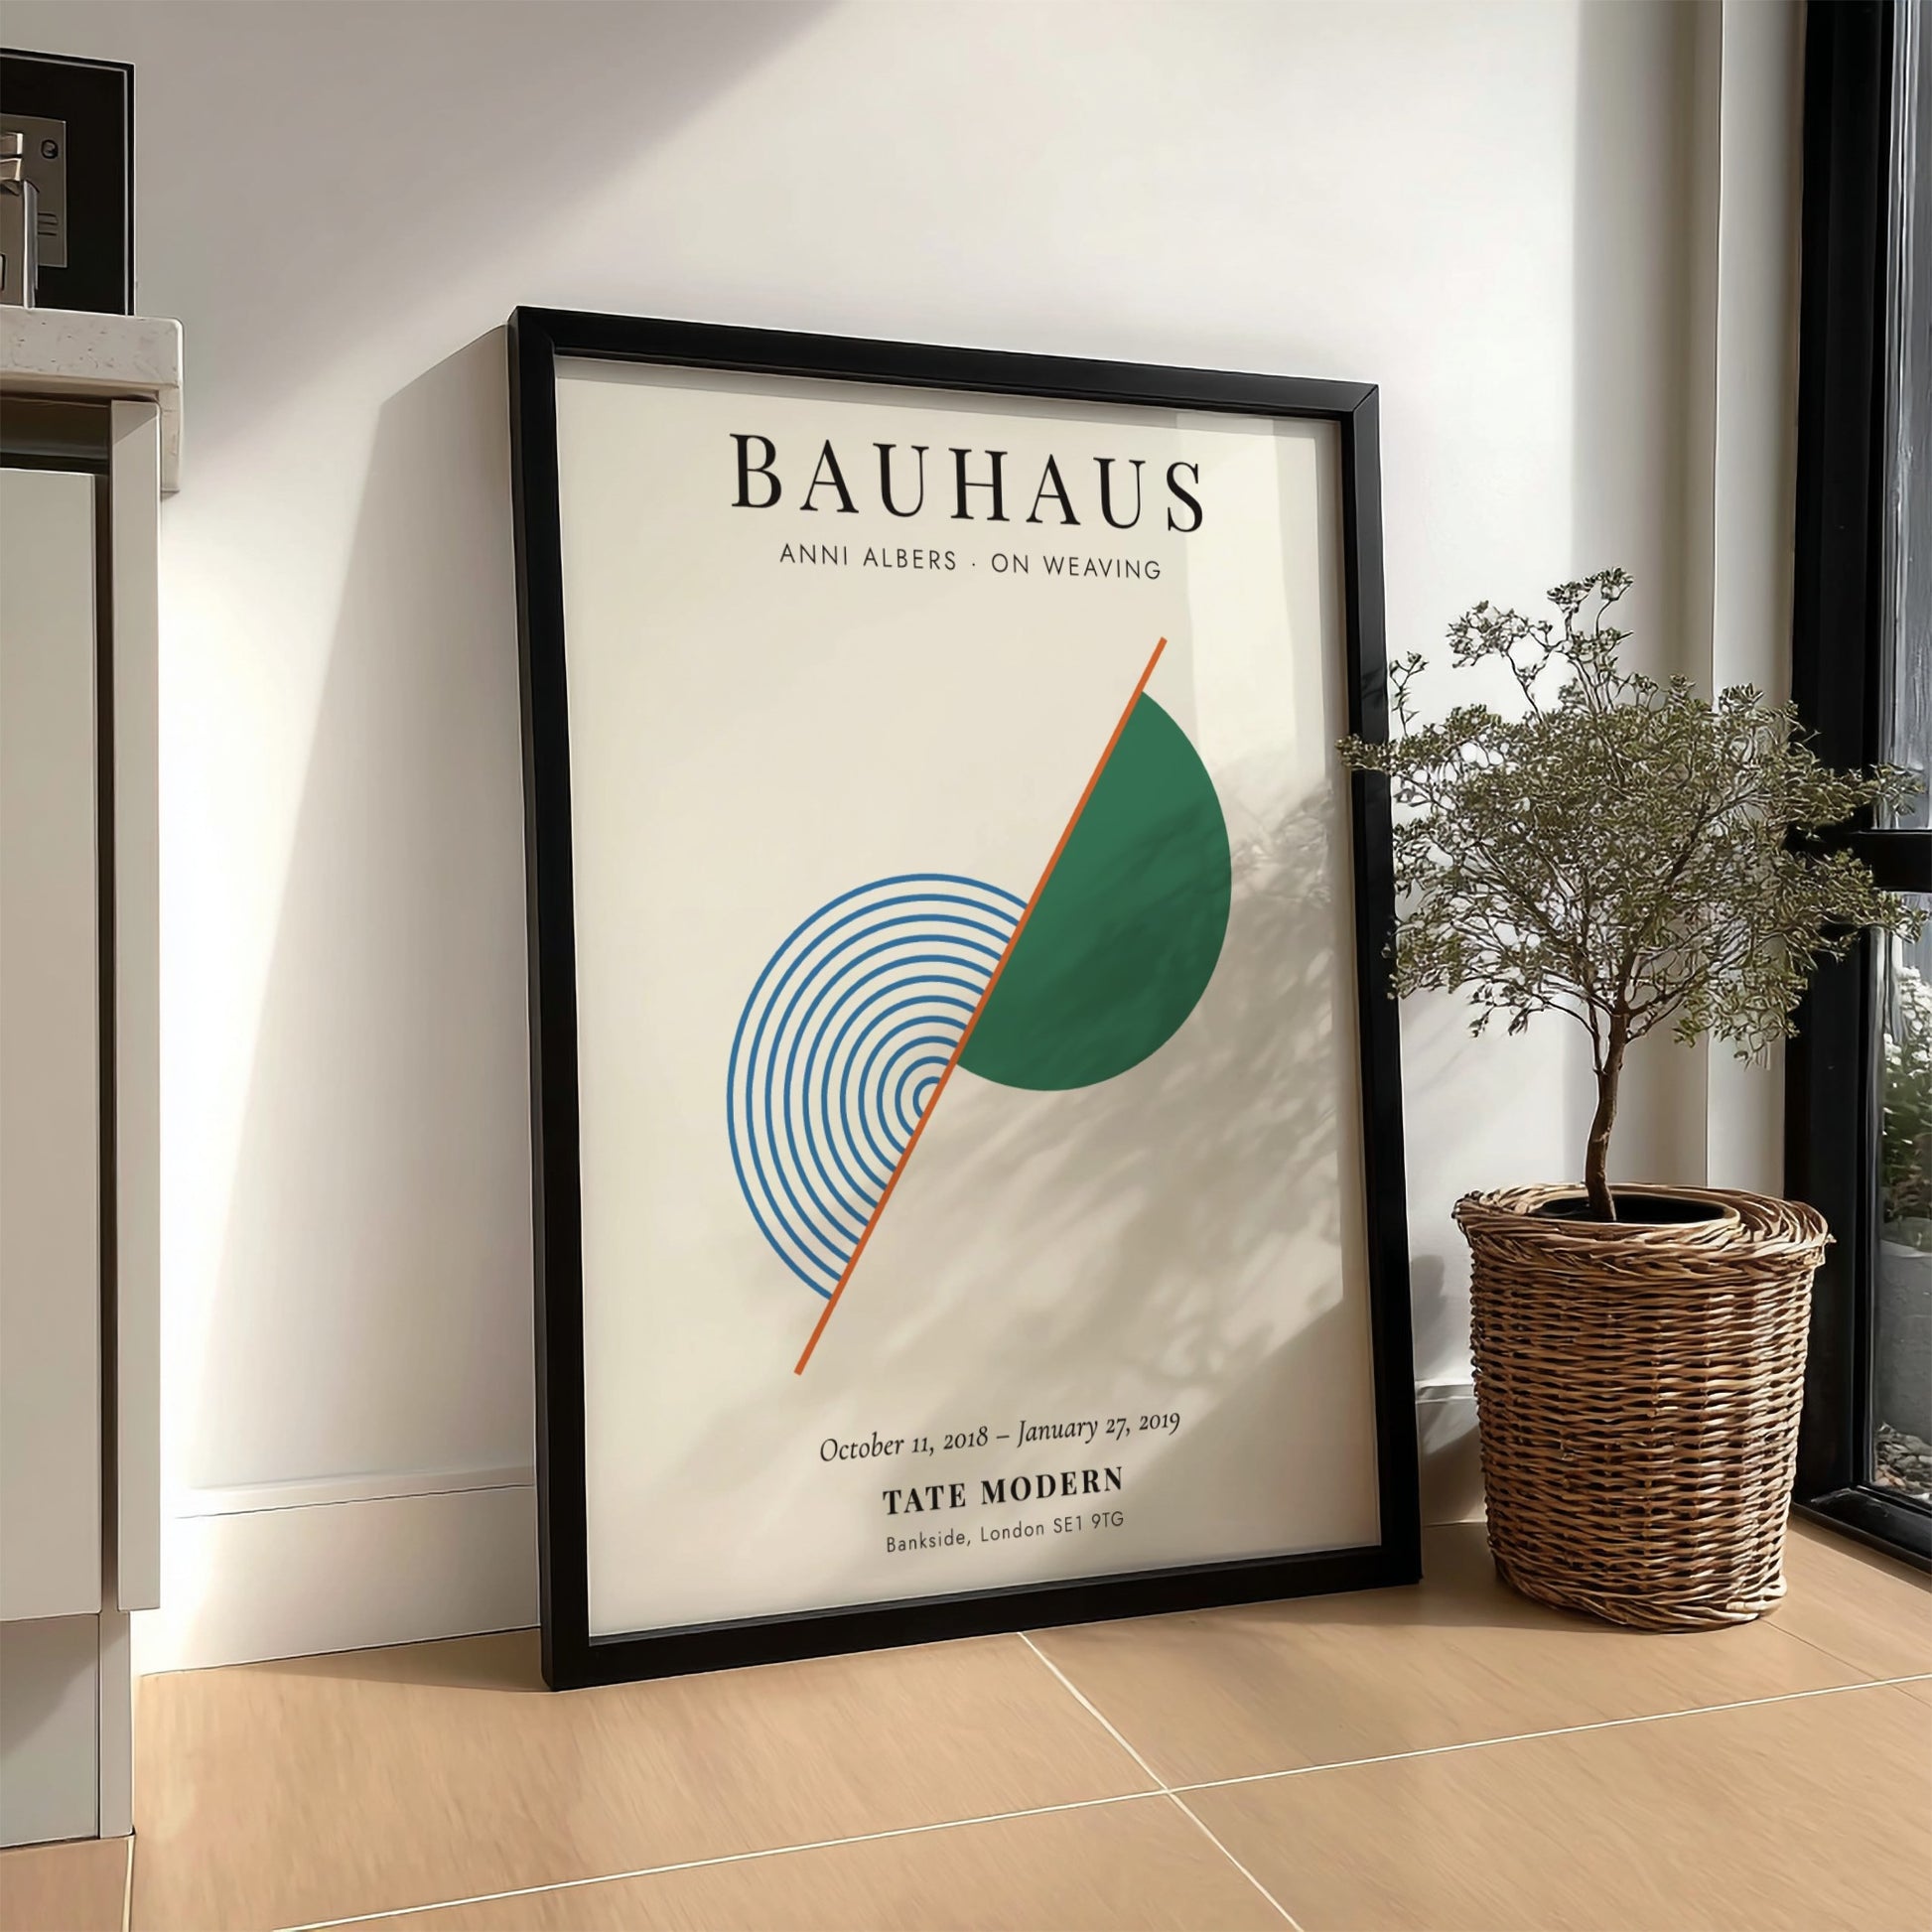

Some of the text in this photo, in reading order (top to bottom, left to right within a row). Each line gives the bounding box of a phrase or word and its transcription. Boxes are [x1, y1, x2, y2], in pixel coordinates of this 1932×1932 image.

[729, 432, 1204, 534] BAUHAUS
[779, 542, 849, 567] ANNI
[861, 546, 957, 573] ALBERS
[990, 552, 1031, 576] ON
[1042, 555, 1163, 582] WEAVING
[819, 1430, 905, 1463] October
[911, 1436, 935, 1458] 11,
[942, 1425, 990, 1451] 2018
[1016, 1420, 1099, 1449] January
[1105, 1417, 1132, 1443] 27,
[1138, 1412, 1181, 1437] 2019
[882, 1465, 1124, 1517] TATE MODERN
[886, 1510, 1126, 1555] Bankside, London SE1 9TG
